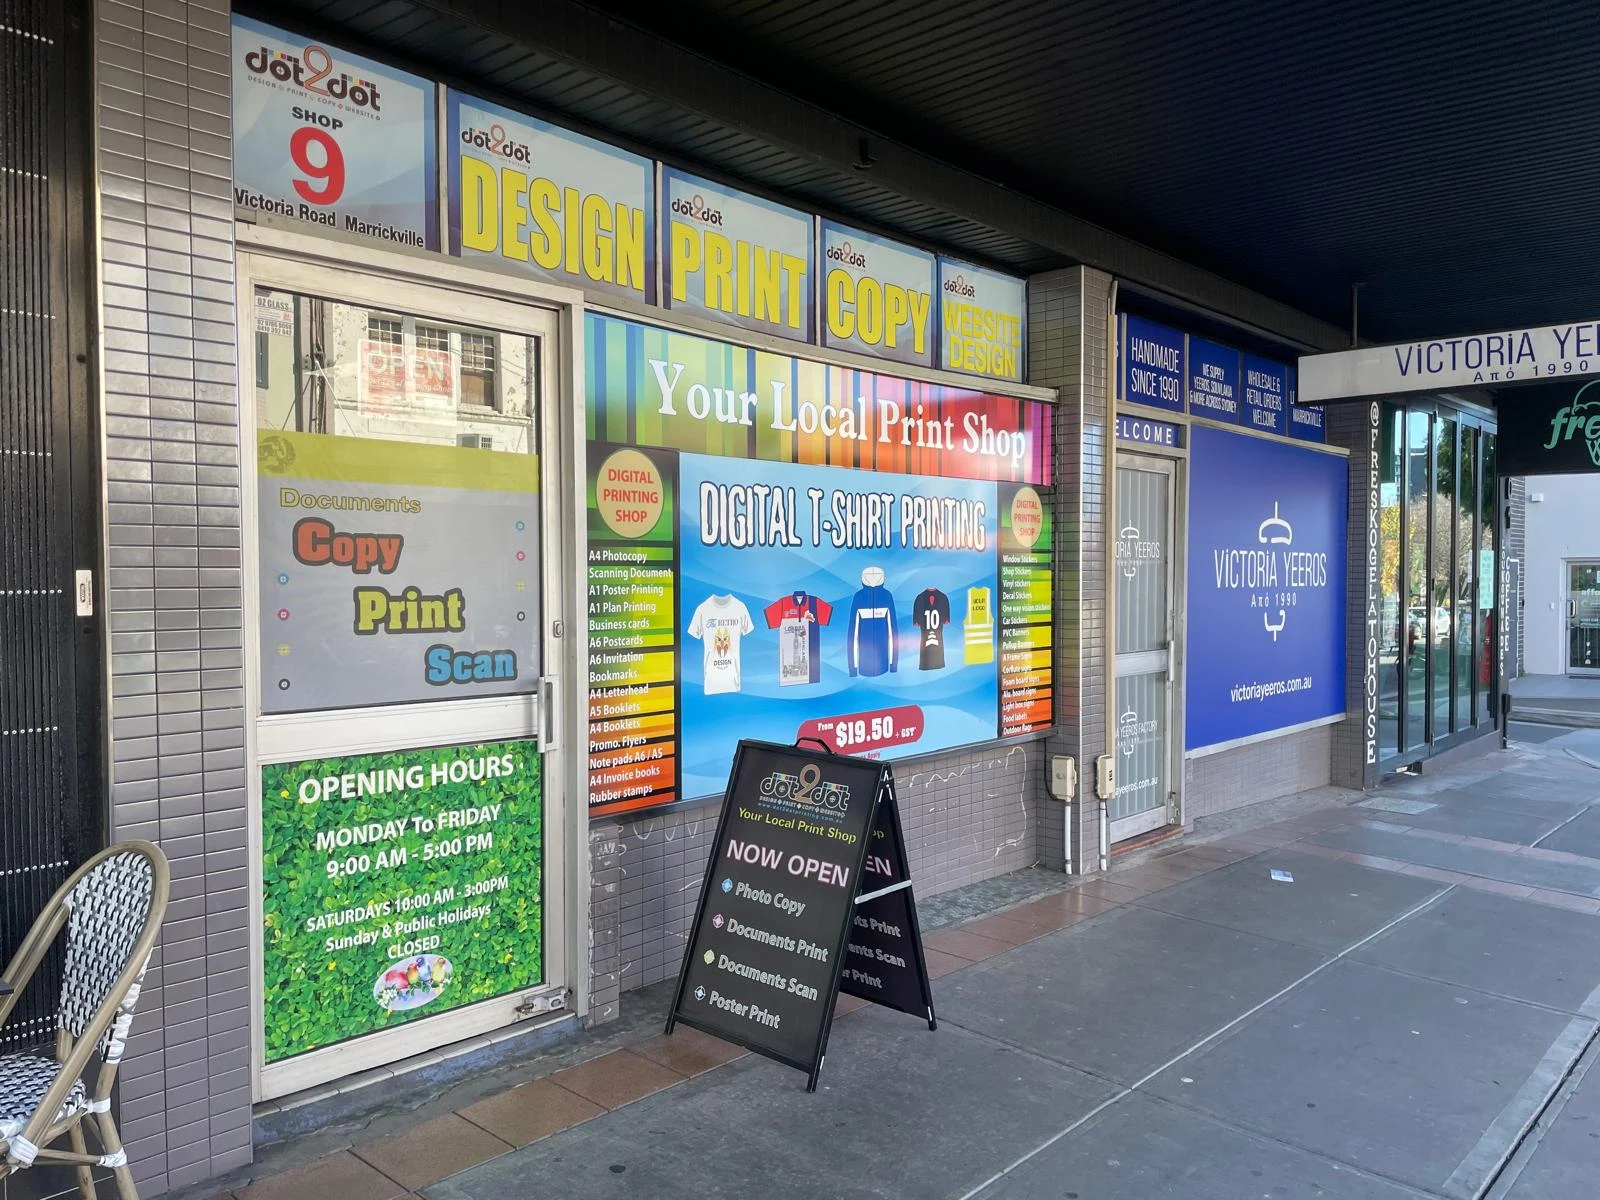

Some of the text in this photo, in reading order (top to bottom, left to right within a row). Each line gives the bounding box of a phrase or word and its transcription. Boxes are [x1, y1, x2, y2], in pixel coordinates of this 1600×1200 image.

[246, 45, 380, 111] dot2dot
[292, 106, 343, 130] SHOP
[462, 124, 530, 163] dot2dot
[290, 127, 345, 205] 9
[235, 188, 424, 247] Victoria Road Marrickville
[672, 195, 722, 226] dot2dot
[461, 155, 644, 292] DESIGN
[672, 221, 806, 329] PRINT
[827, 269, 930, 354] COPY
[944, 298, 1020, 347] WEBSITE
[1553, 324, 1600, 359] YE
[950, 336, 1015, 378] DESIGN
[1132, 337, 1179, 373] HANDMADE
[1203, 363, 1224, 380] WE SUPPLY
[1533, 360, 1588, 376] 1990
[1132, 368, 1178, 402] SINCE 1990
[1248, 370, 1276, 391] WHOLESALE
[1194, 392, 1236, 413] MORE ACROSS SYDNEY
[1247, 388, 1262, 406] RETAIL
[1264, 393, 1281, 411] ORDERS
[649, 358, 1025, 467] Your Local Print Shop
[1253, 408, 1276, 428] WELCOME
[1293, 408, 1321, 427] MARRICKVILLE
[1116, 419, 1172, 444] ELCOME
[608, 469, 653, 483] DIGITAL
[280, 488, 421, 513] Documents
[604, 489, 658, 503] PRINTING
[1017, 501, 1038, 509] DIGITAL
[616, 510, 647, 522] SHOP
[700, 481, 986, 551] DIGITAL T-SHIRT PRINTING
[1014, 513, 1040, 523] PRINTING
[1020, 528, 1035, 536] SHOP
[293, 517, 404, 574] Copy
[1134, 542, 1159, 558] YEEROS
[589, 550, 647, 563] A4 Photocopy
[1003, 555, 1020, 563] Window
[589, 568, 628, 580] Scanning
[1003, 568, 1014, 576] Shop
[1284, 552, 1326, 587] YEEROS
[589, 585, 663, 596] A1 Poster Printing
[1003, 591, 1015, 600] Decal
[1275, 592, 1297, 606] 1990
[354, 586, 465, 635] Print
[589, 602, 656, 613] A1 Plan Printing
[590, 618, 649, 630] Business cards
[925, 610, 939, 629] 10
[590, 636, 643, 648] A6 Postcards
[1003, 629, 1012, 637] PVC
[425, 644, 517, 686] Scan
[590, 652, 644, 665] A6 Invitation
[590, 669, 638, 682] Bookmarks
[590, 684, 649, 699] A4 Letterhead
[1231, 676, 1312, 702] victoriayeeros.com.au
[590, 703, 640, 716] A5 Booklets
[1003, 714, 1014, 722] Food
[590, 720, 640, 734] A4 Booklets
[818, 716, 893, 748] From $19.50
[1003, 726, 1021, 735] Outdoor
[1120, 722, 1137, 737] YEEROS
[1139, 720, 1158, 734] FACTORY
[590, 735, 646, 752] Promo. Flyers
[590, 748, 663, 769] Note pads A6 A5
[299, 754, 514, 803] OPENING HOURS
[590, 766, 660, 786] A4 Invoice books
[590, 784, 653, 803] Rubber stamps
[760, 764, 850, 810] dot2dot
[1116, 777, 1158, 797] ayeeros.com.au
[316, 804, 501, 850] MONDAY To FRIDAY
[738, 807, 856, 844] Your Local Print Shop
[326, 832, 492, 879] 9:00 AM 5:00 PM
[726, 839, 849, 887] NOW OPEN
[866, 856, 891, 876] EN
[307, 877, 508, 932] SATURDAYS 10:00 AM 3:00PM
[735, 882, 805, 917] Photo Copy
[326, 903, 491, 952] Sunday & Public Holidays
[870, 918, 901, 937] Print
[388, 936, 440, 959] CLOSED
[727, 918, 795, 951] Documents
[797, 939, 828, 962] Print
[876, 949, 905, 968] Scan
[718, 955, 818, 1001] Documents Scan
[852, 969, 882, 988] Print
[710, 991, 781, 1029] Poster Print
